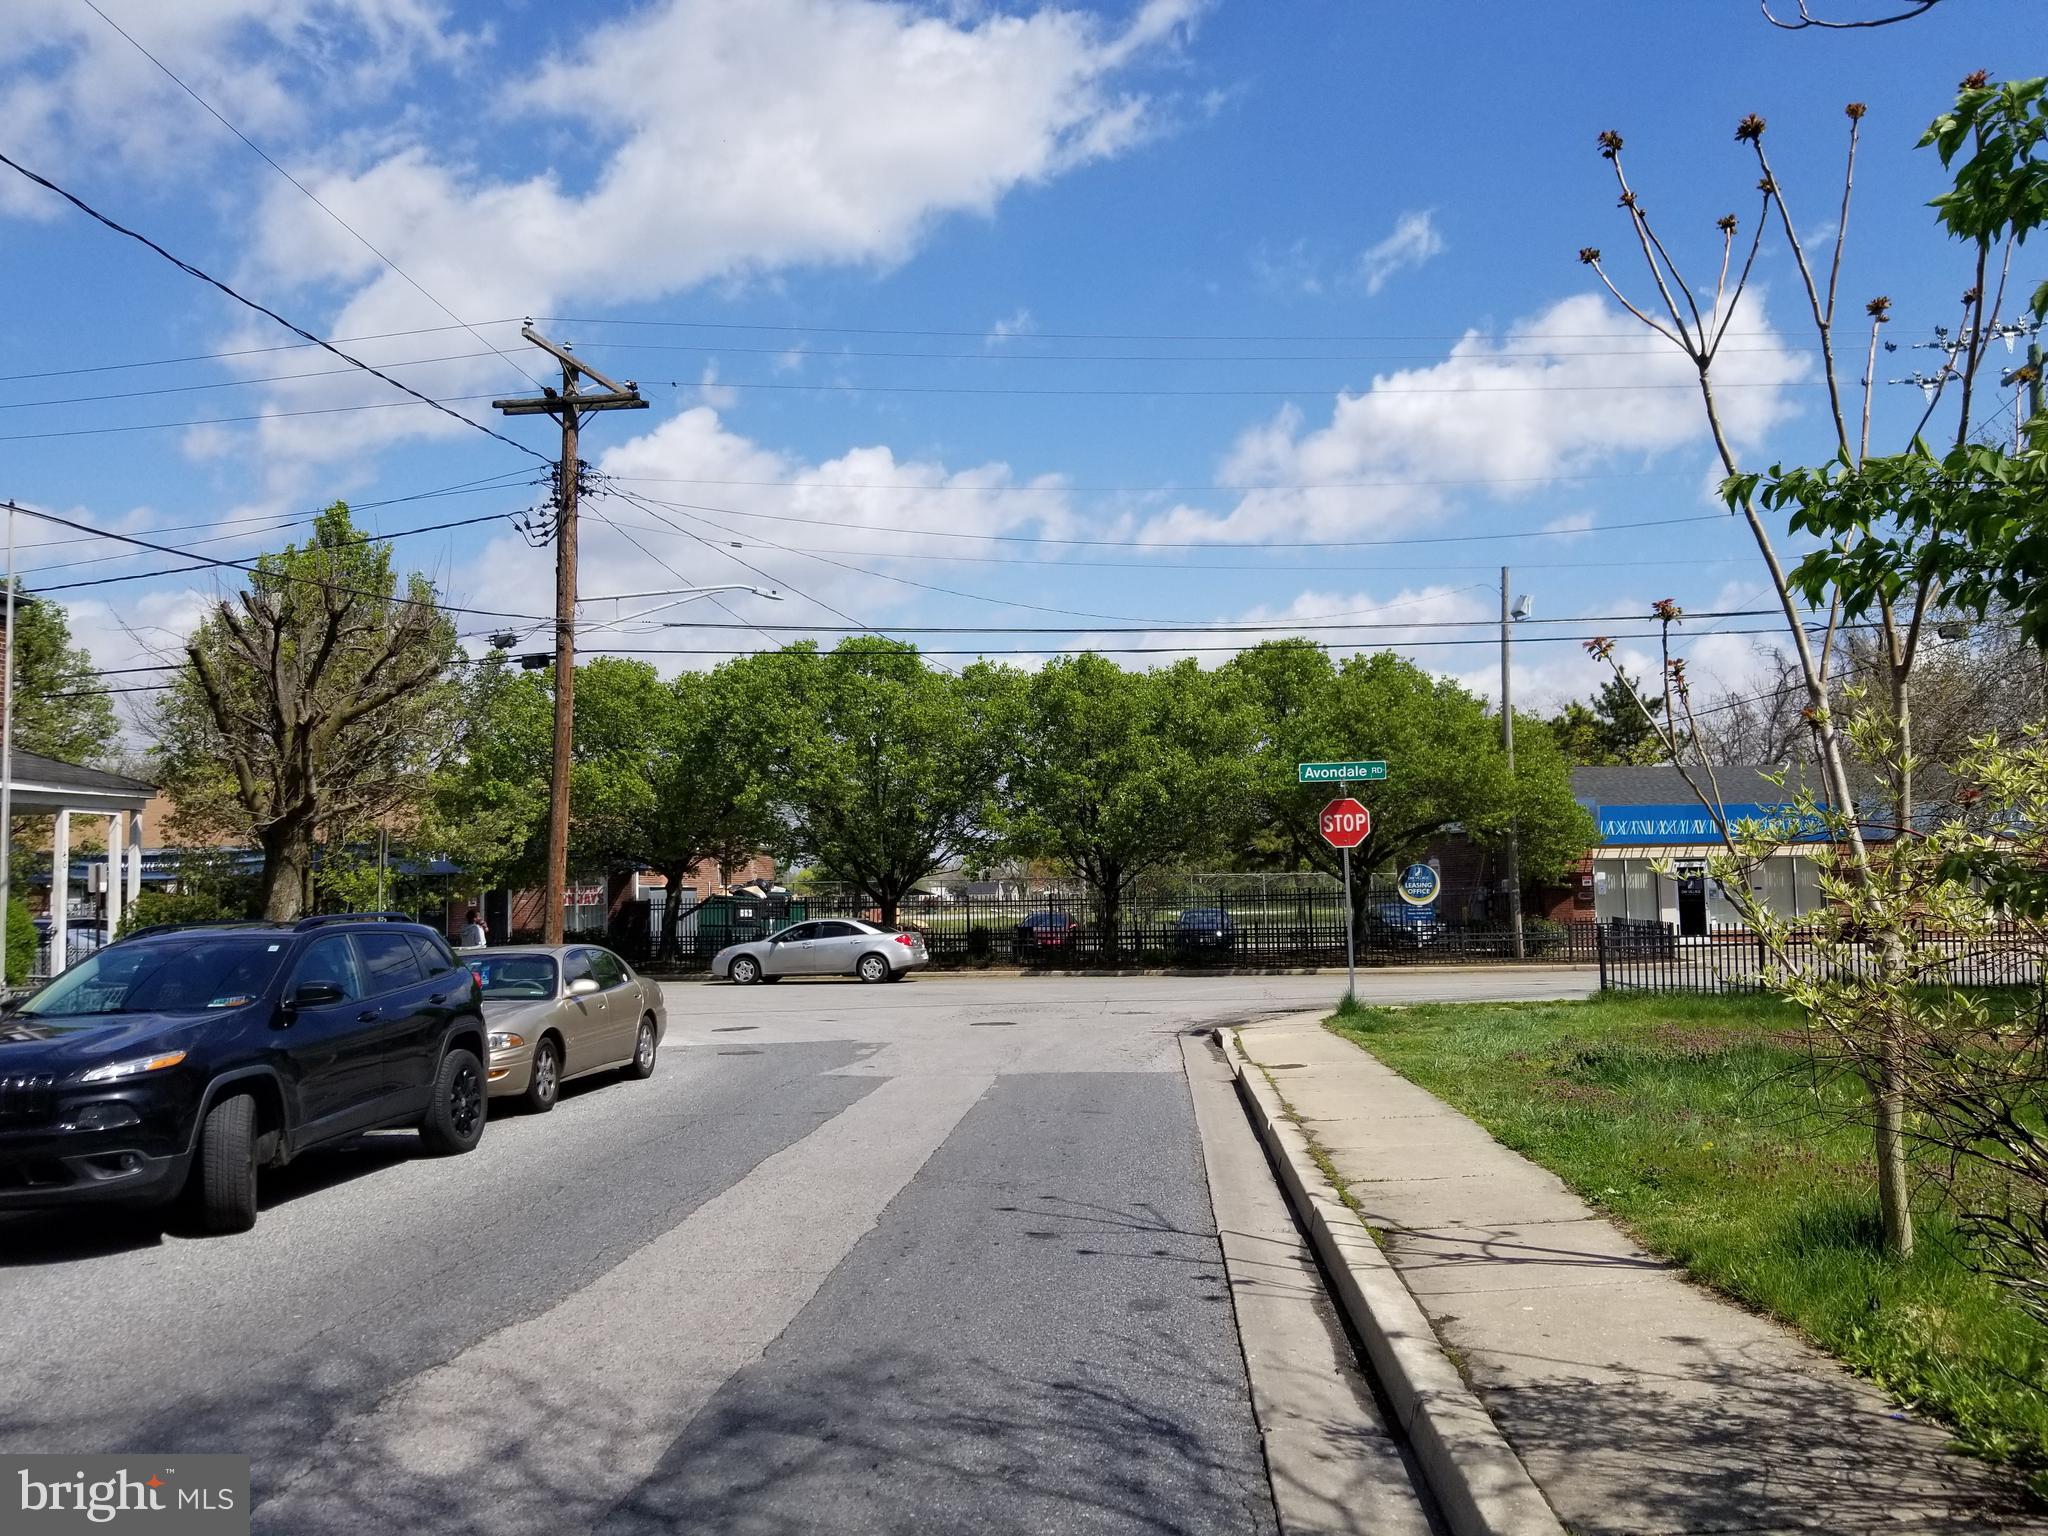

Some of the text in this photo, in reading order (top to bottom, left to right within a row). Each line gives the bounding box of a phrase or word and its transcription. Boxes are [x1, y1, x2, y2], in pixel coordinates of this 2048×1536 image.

[1305, 766, 1383, 778] Avondale RD
[1324, 814, 1366, 833] STOP
